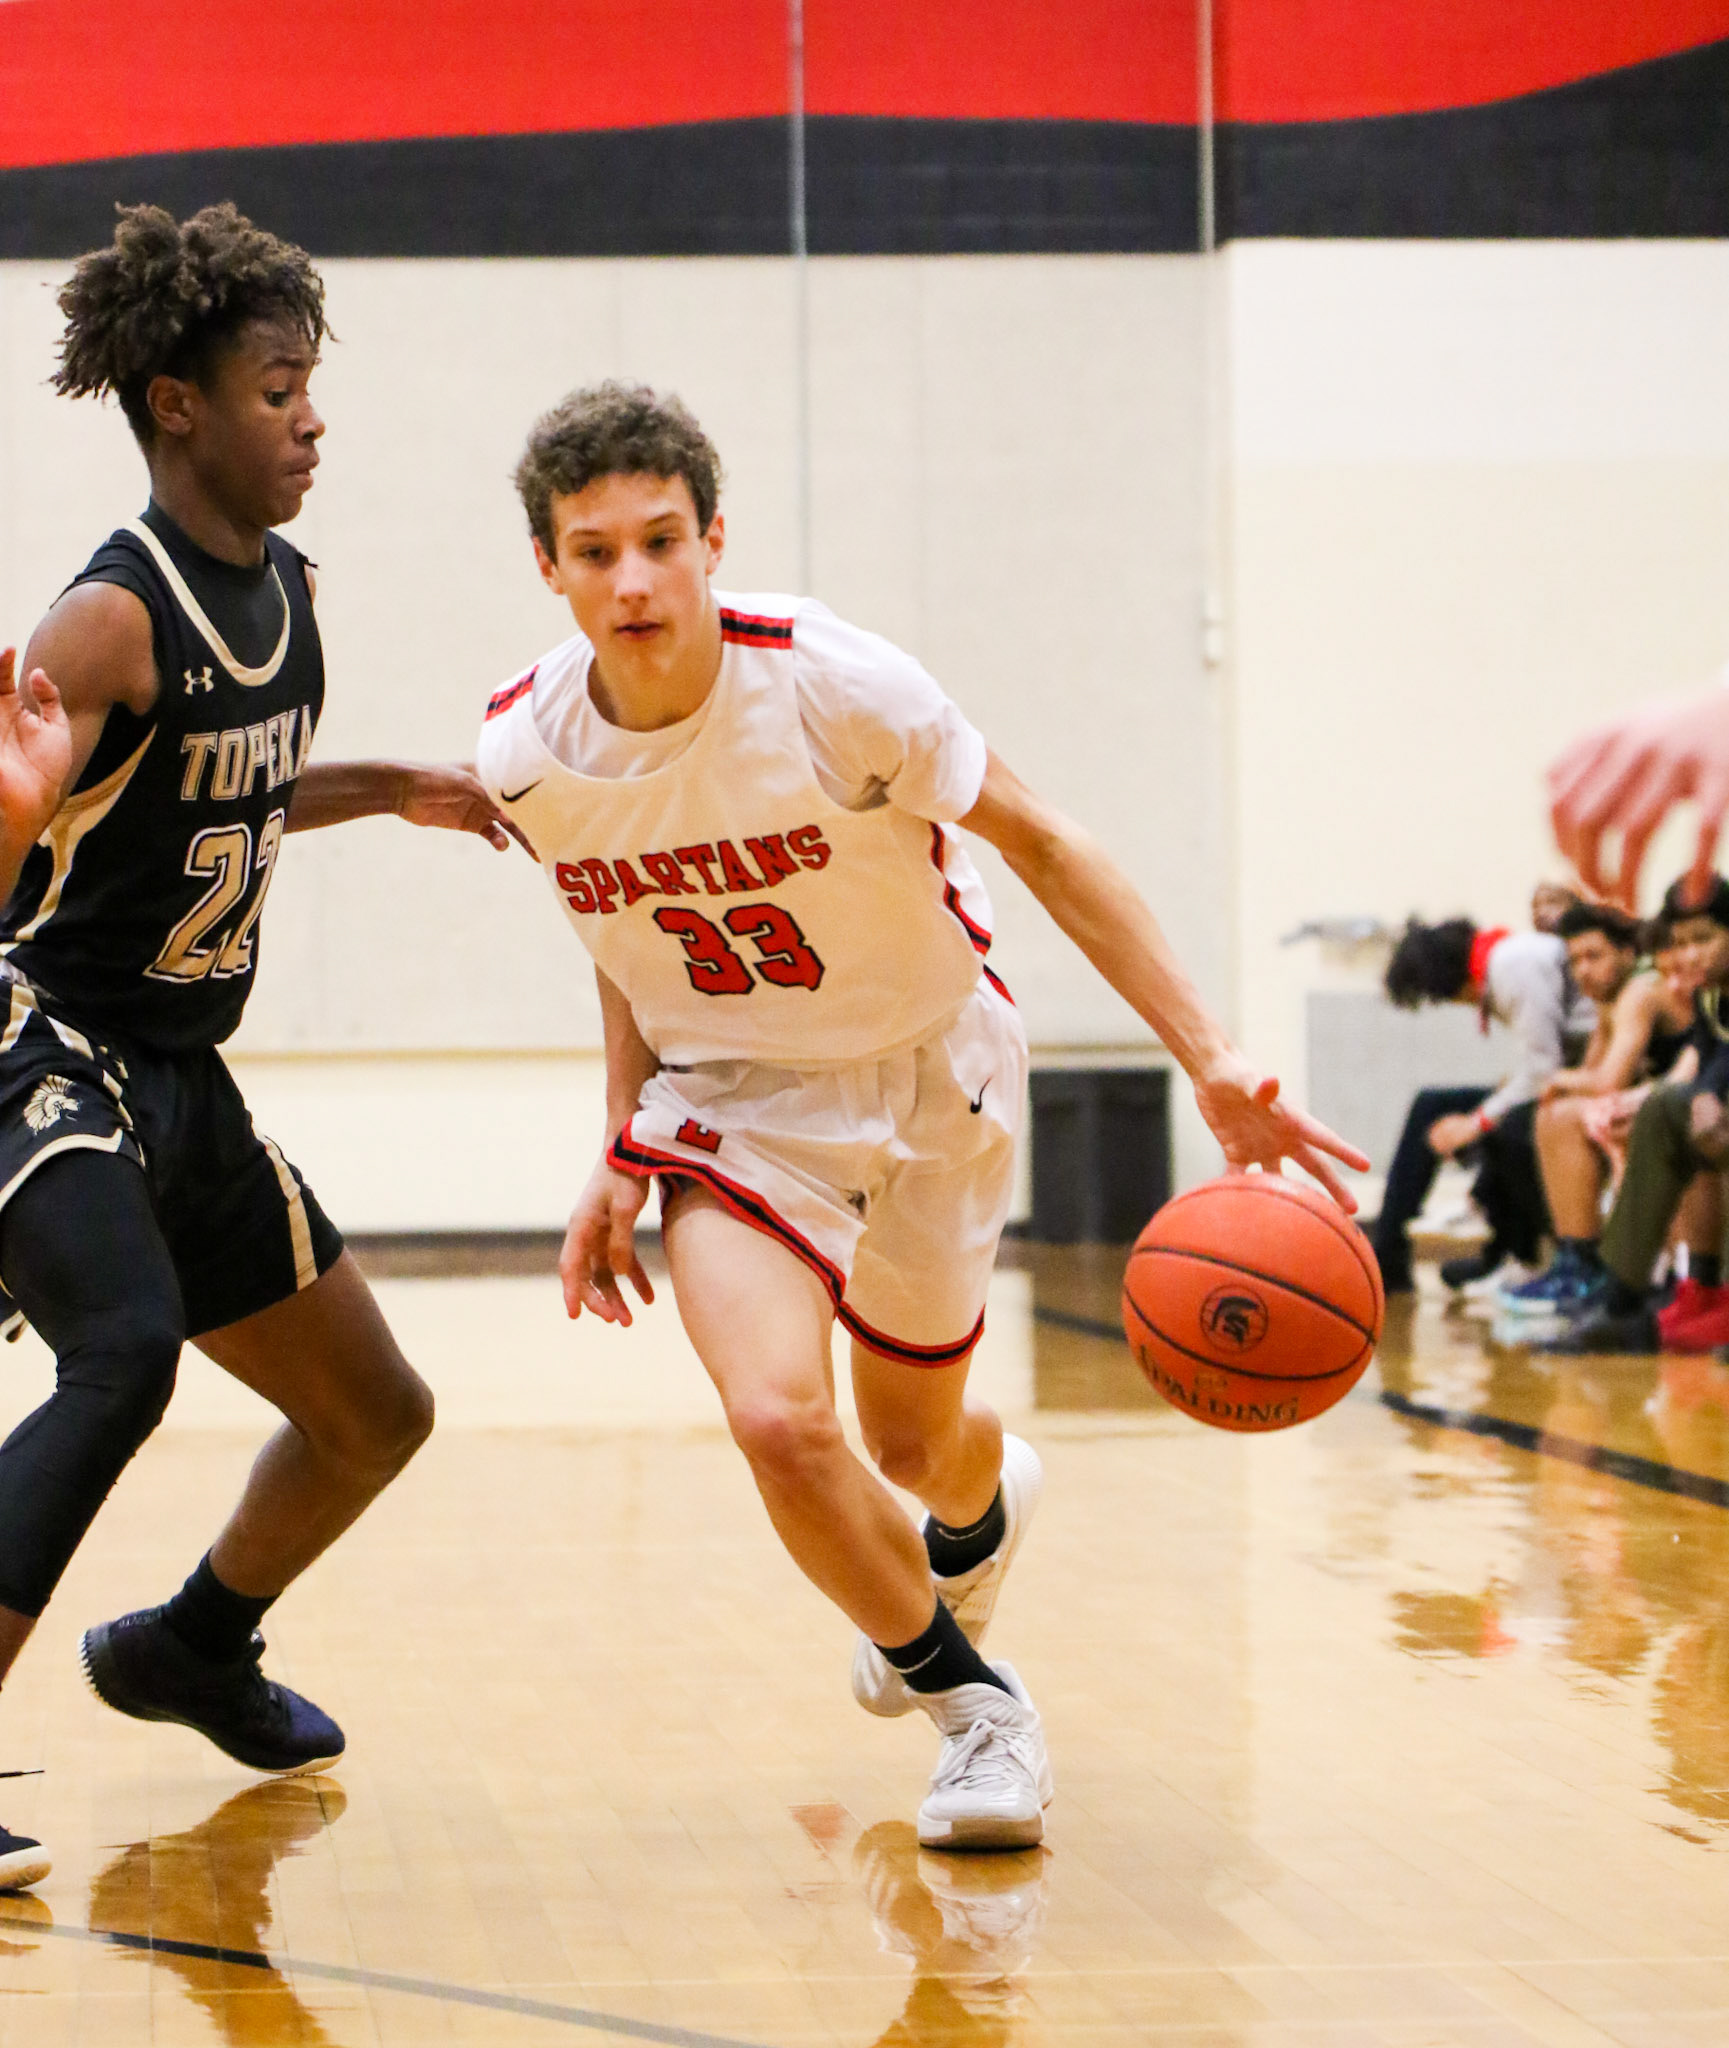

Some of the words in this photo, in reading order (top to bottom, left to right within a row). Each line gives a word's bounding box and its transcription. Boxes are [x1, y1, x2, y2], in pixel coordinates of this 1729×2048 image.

[180, 704, 313, 801] TOPEKA
[142, 807, 286, 984] 22
[556, 824, 832, 914] SPARTANS
[652, 902, 826, 996] 33
